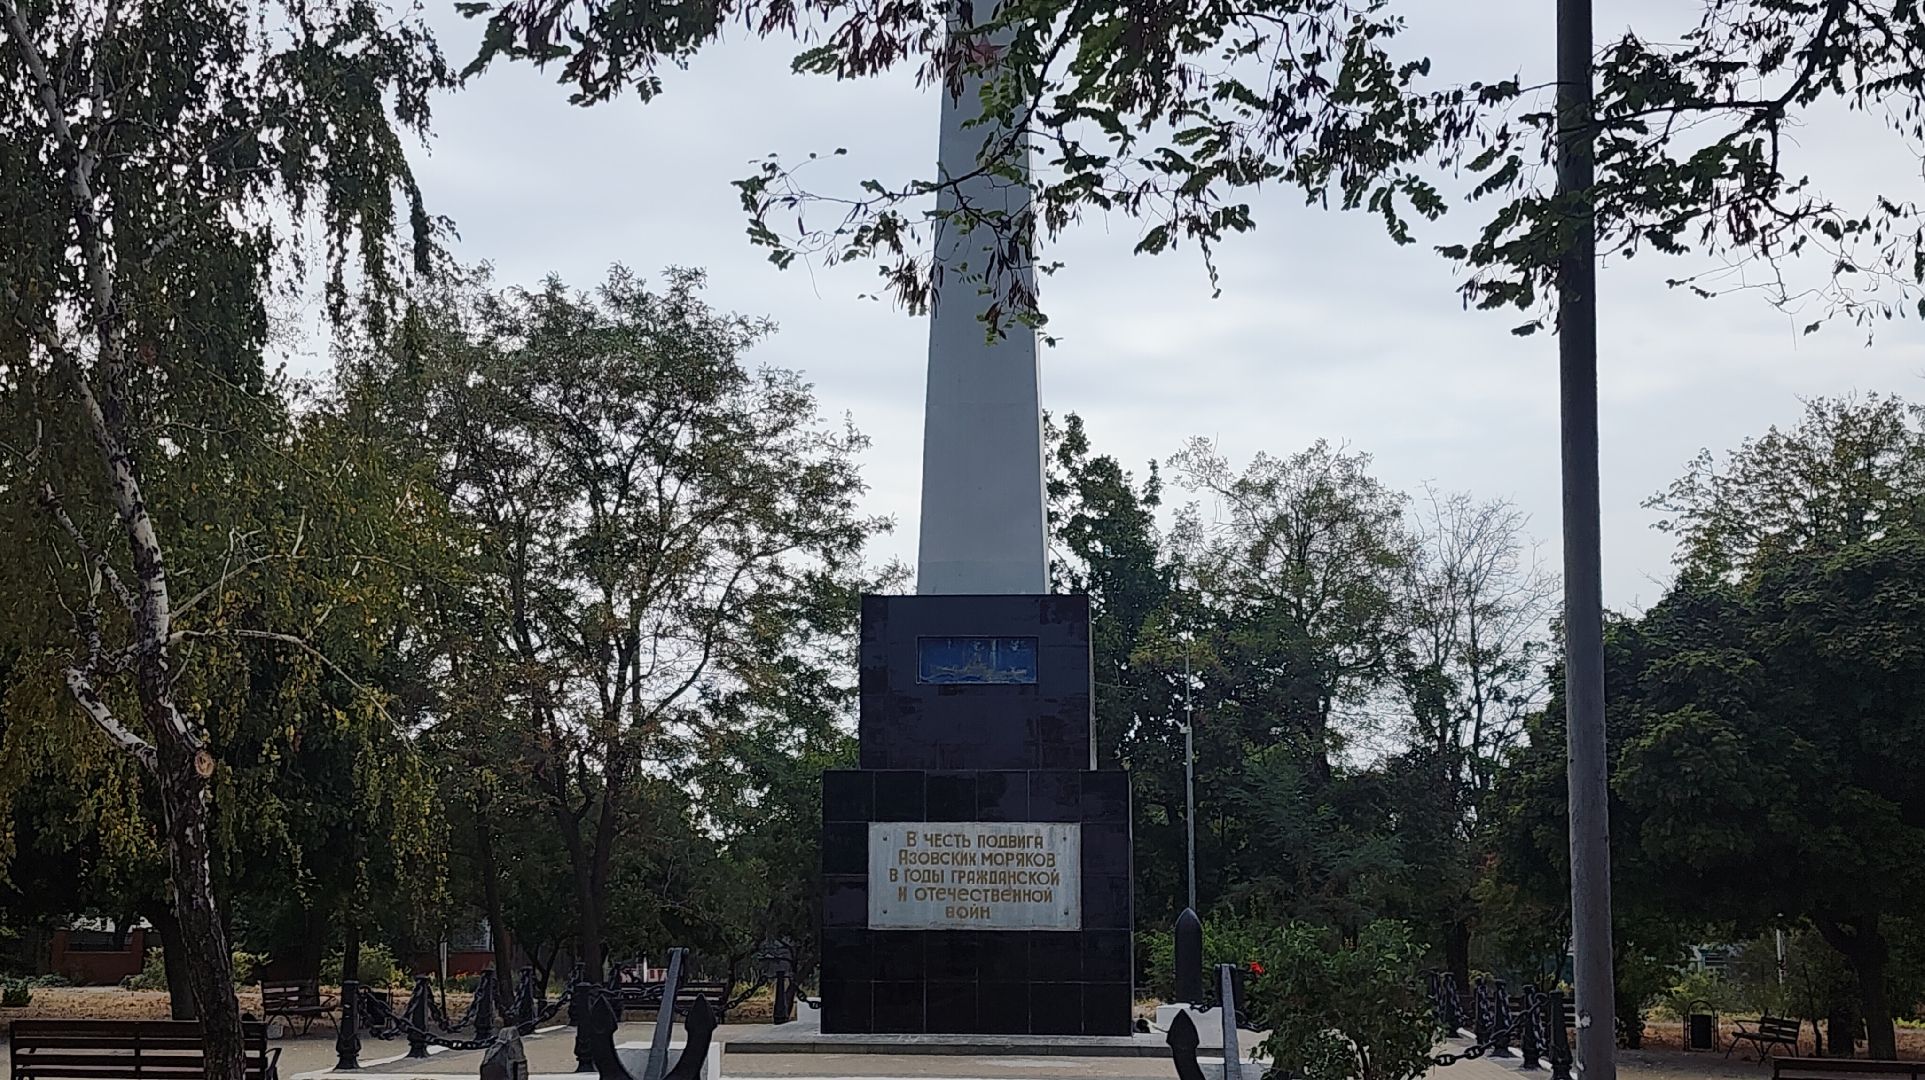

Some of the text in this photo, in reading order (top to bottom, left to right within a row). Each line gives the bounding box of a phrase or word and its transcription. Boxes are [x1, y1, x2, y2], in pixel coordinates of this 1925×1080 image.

[906, 831, 1044, 849] В ЧЕСТЬ ПОДВИГА
[898, 849, 1056, 868] АЗОВСКИХ МОРЯКОВ
[889, 868, 1060, 886] В ГОДЫ ГРАЖДАНСКОЙ
[898, 886, 1053, 903] И ОТЕЧЕСТВЕННОЙ
[945, 903, 991, 920] ВОЙН
